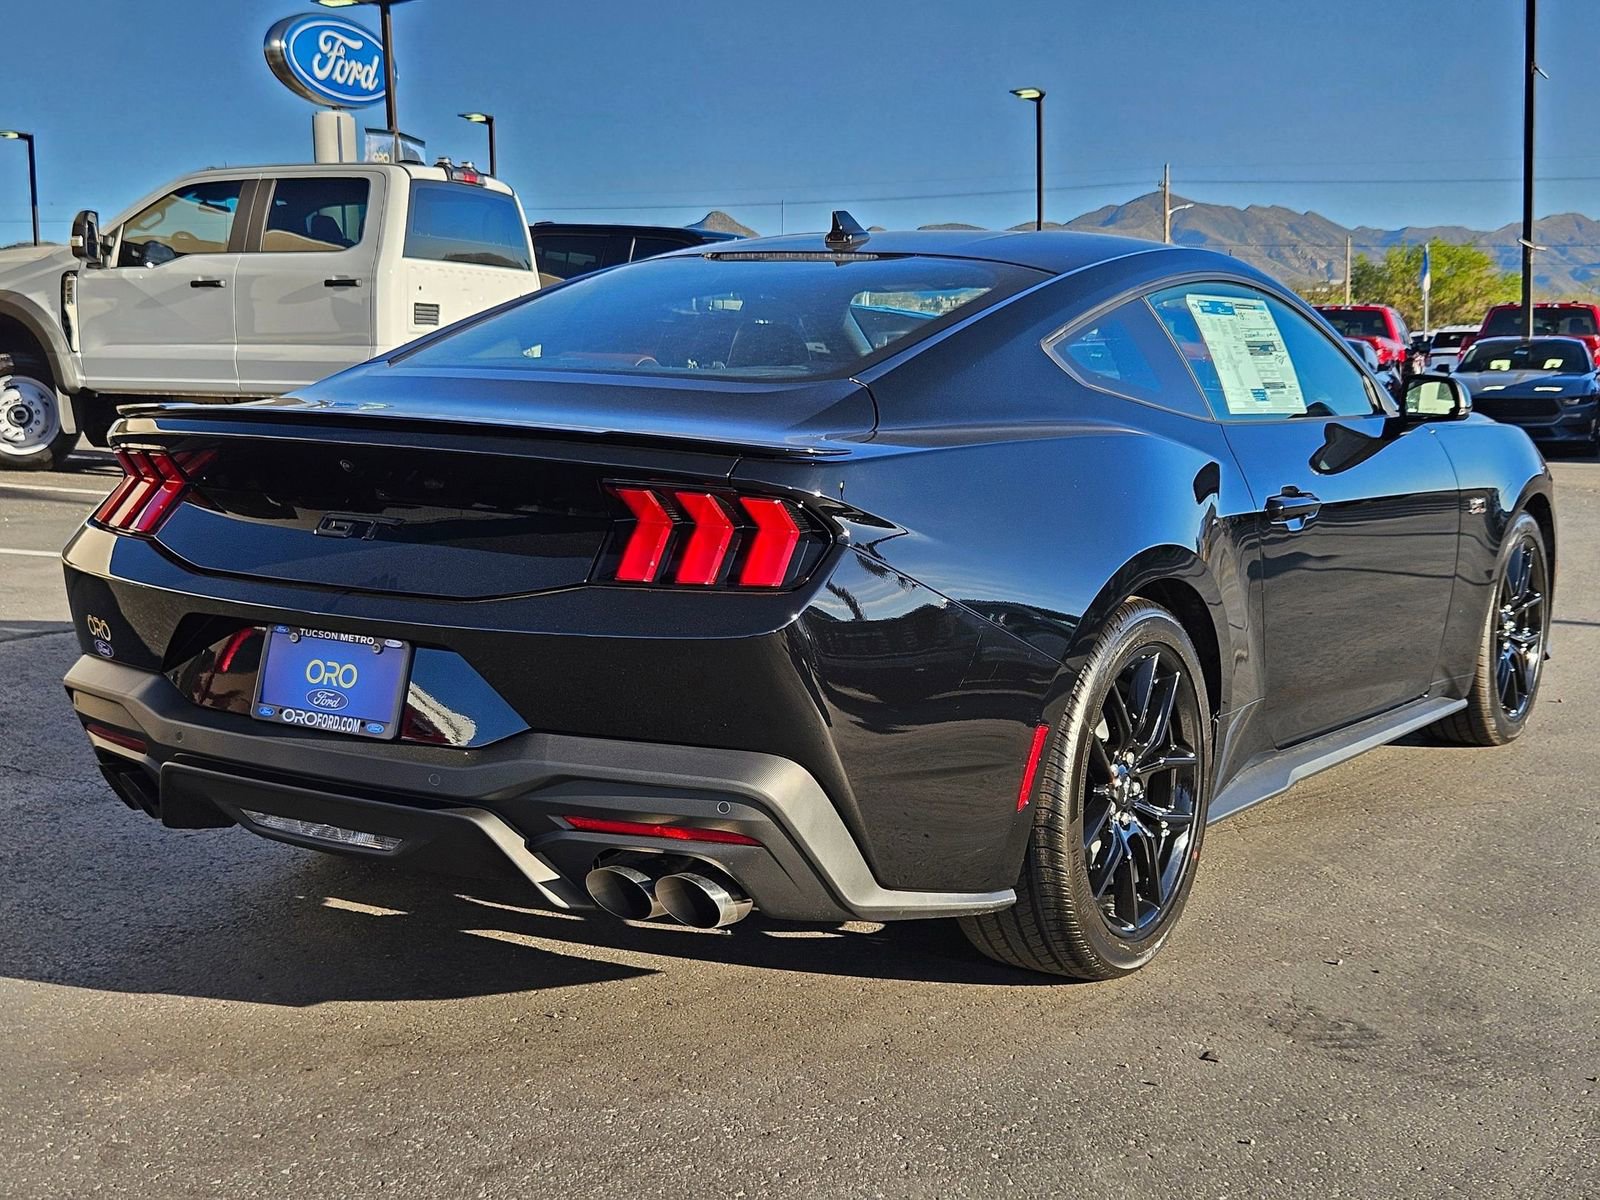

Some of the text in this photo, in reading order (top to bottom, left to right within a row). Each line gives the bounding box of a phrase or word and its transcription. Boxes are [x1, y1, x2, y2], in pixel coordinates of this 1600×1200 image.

[312, 29, 380, 91] Ford
[313, 511, 407, 541] GT
[87, 614, 111, 641] ORO
[299, 627, 339, 641] TUCSON
[340, 633, 375, 645] METRO
[305, 659, 358, 689] ORO
[313, 691, 340, 708] Ford
[282, 708, 361, 733] OROFORD.COM
